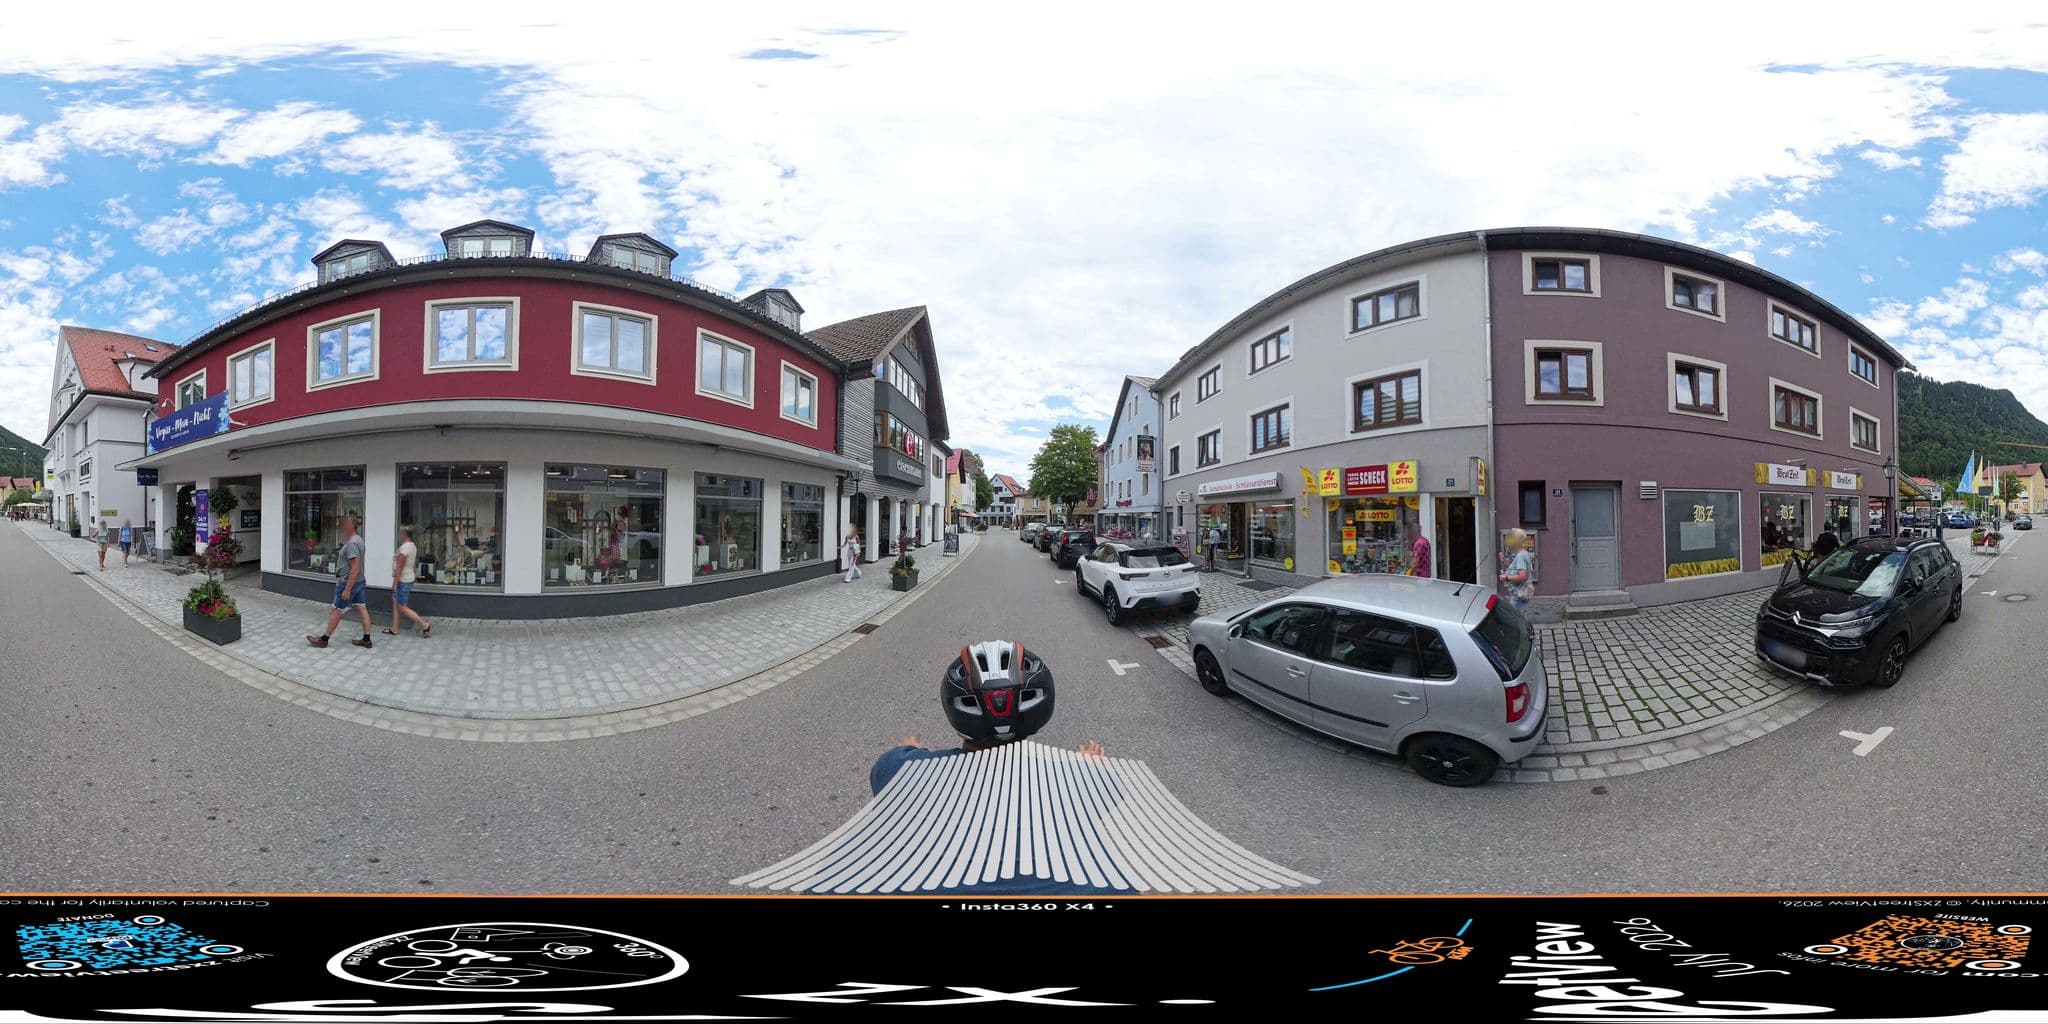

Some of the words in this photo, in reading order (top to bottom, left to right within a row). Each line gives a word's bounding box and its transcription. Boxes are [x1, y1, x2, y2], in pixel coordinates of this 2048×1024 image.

[1359, 470, 1386, 485] SCHECK
[1321, 482, 1338, 490] LOTTO
[1368, 511, 1390, 519] LOTTO
[1693, 504, 1715, 524] BZ
